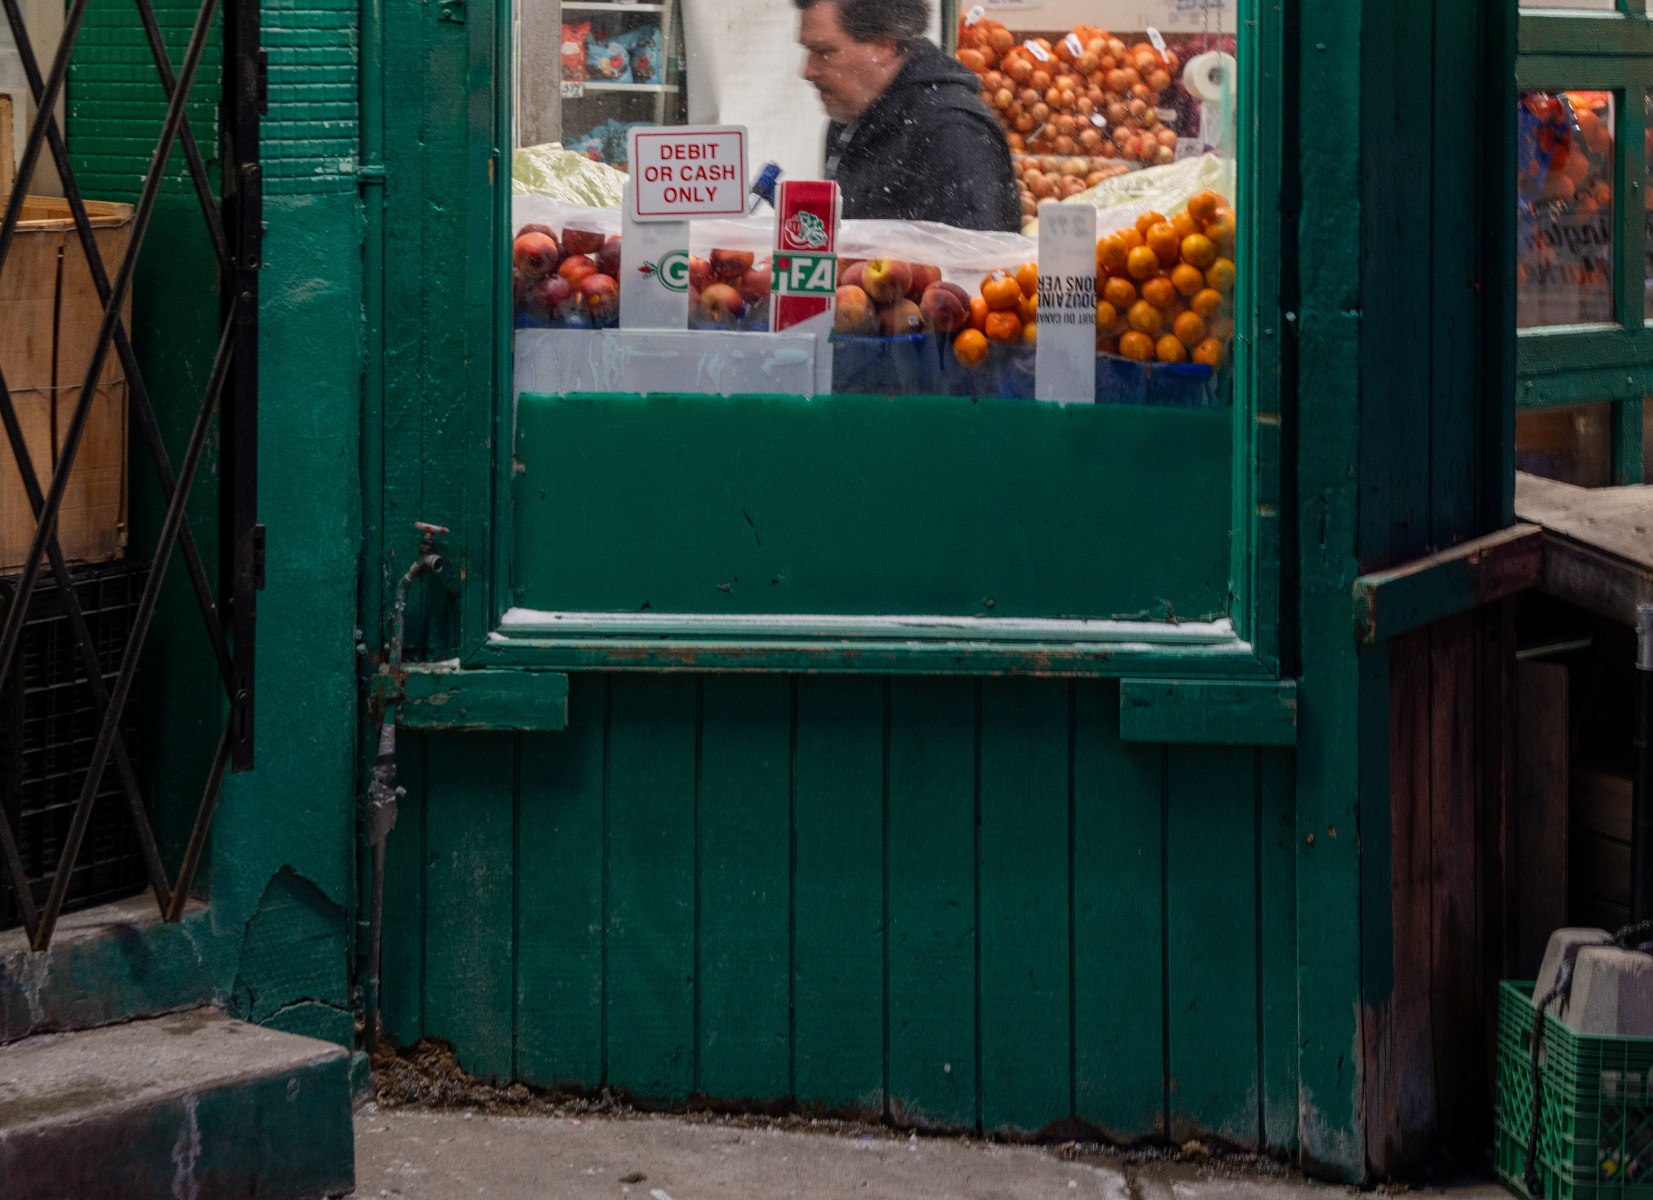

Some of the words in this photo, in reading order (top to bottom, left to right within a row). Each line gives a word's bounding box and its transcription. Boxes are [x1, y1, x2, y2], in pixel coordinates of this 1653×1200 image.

[660, 143, 719, 160] DEBIT
[644, 166, 673, 182] OR
[680, 165, 736, 182] CASH
[663, 186, 718, 203] ONLY
[1037, 312, 1061, 325] CANA
